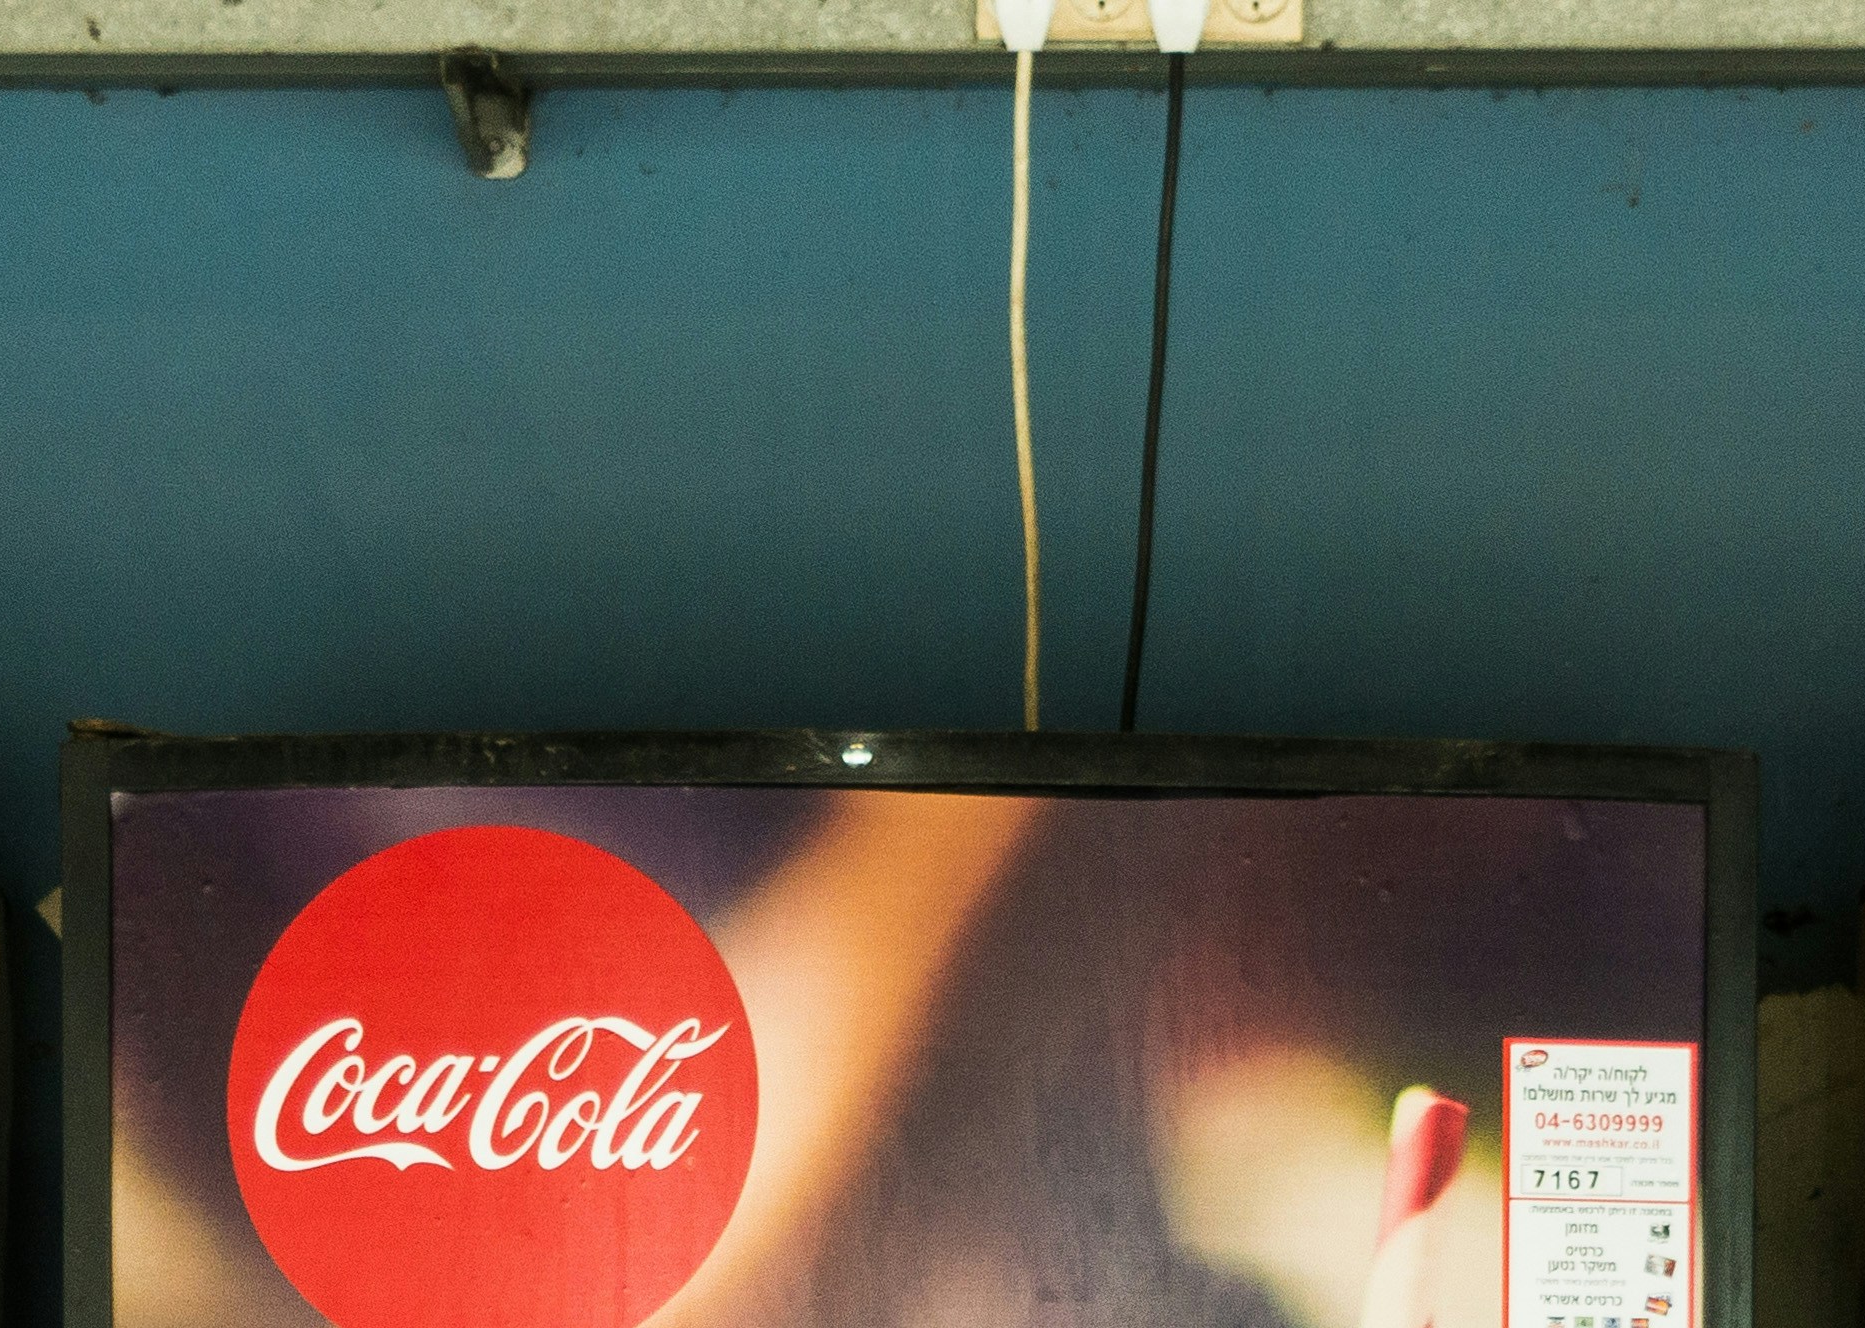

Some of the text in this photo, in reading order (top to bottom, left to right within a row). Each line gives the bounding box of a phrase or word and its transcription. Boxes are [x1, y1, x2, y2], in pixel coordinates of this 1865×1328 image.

[1553, 1066, 1593, 1083] יקר/ה
[253, 1015, 733, 1172] Coca-Cola
[1523, 1085, 1677, 1107] מגיע לך שרות מושלם!
[1535, 1112, 1663, 1132] 04-6309999
[1534, 1169, 1599, 1190] 7167
[1565, 1222, 1598, 1237] מזומן
[1565, 1246, 1603, 1257] כרטיס
[1585, 1295, 1623, 1307] כרטיס
